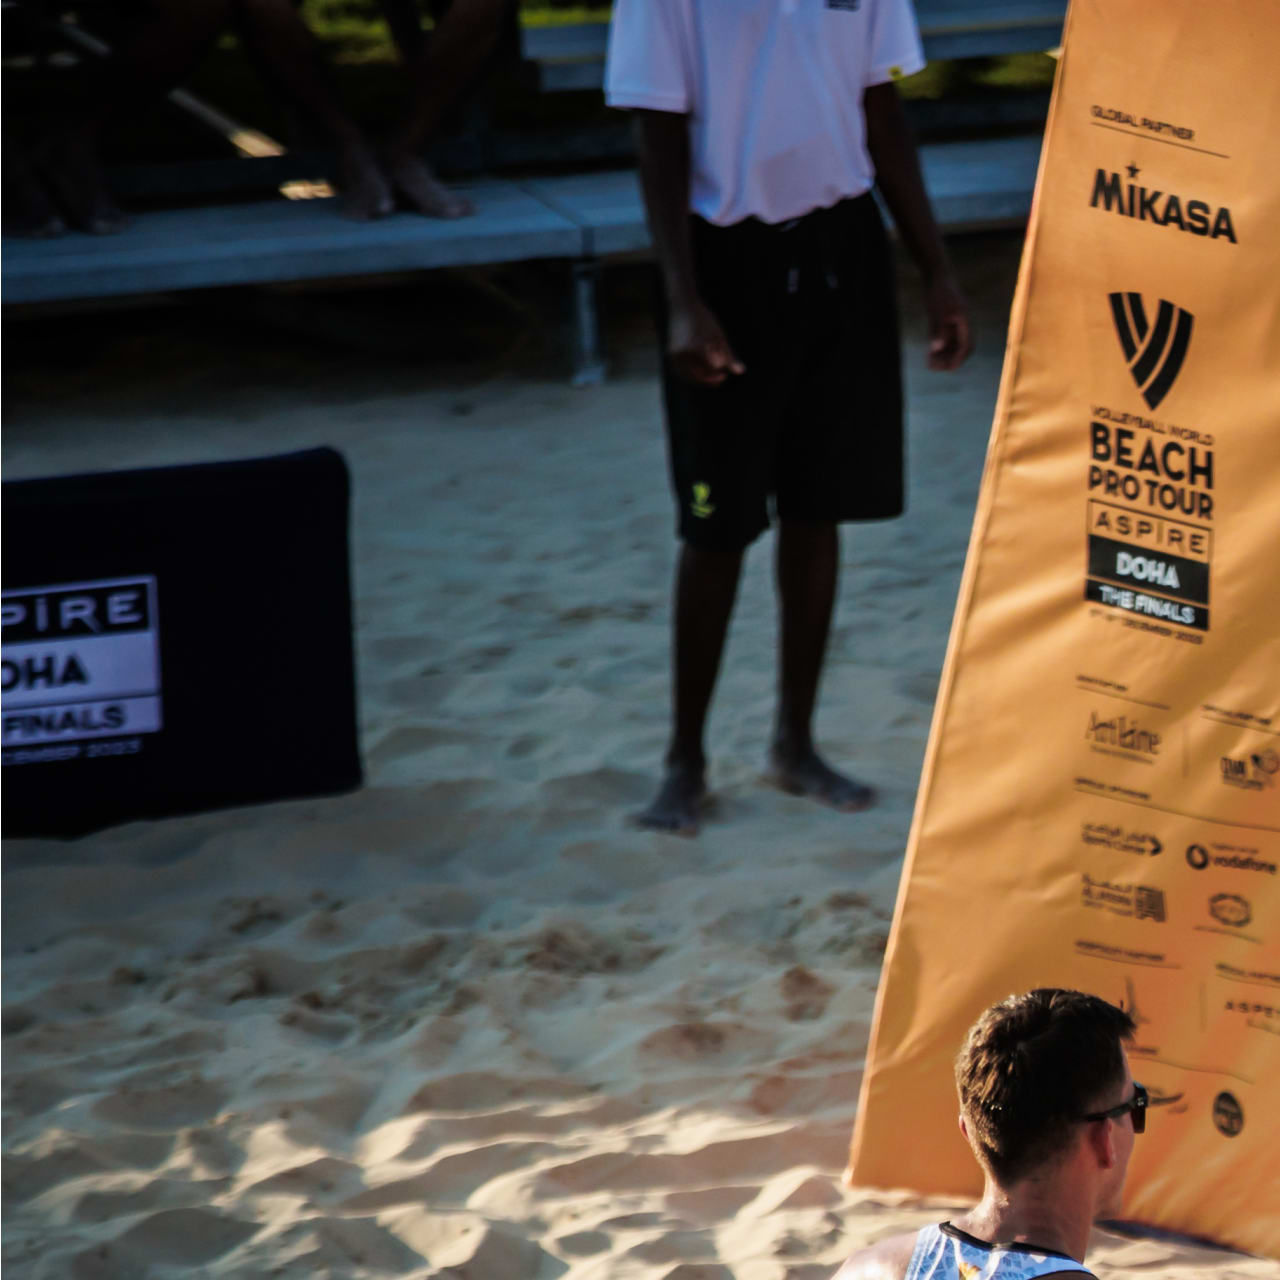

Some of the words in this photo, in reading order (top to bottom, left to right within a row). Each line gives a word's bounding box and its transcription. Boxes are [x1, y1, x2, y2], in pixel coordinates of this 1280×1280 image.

[1090, 104, 1138, 129] GLOBAL
[1141, 115, 1196, 142] PARTNER
[1090, 421, 1214, 490] BEACH
[1088, 465, 1141, 501] PRO
[1145, 479, 1213, 521] TOUR
[1095, 511, 1207, 554] ASPIRE
[1116, 551, 1181, 589] DOHA
[1099, 585, 1135, 610] THE
[1135, 594, 1196, 625] FINALS
[4, 704, 127, 741] FINALS
